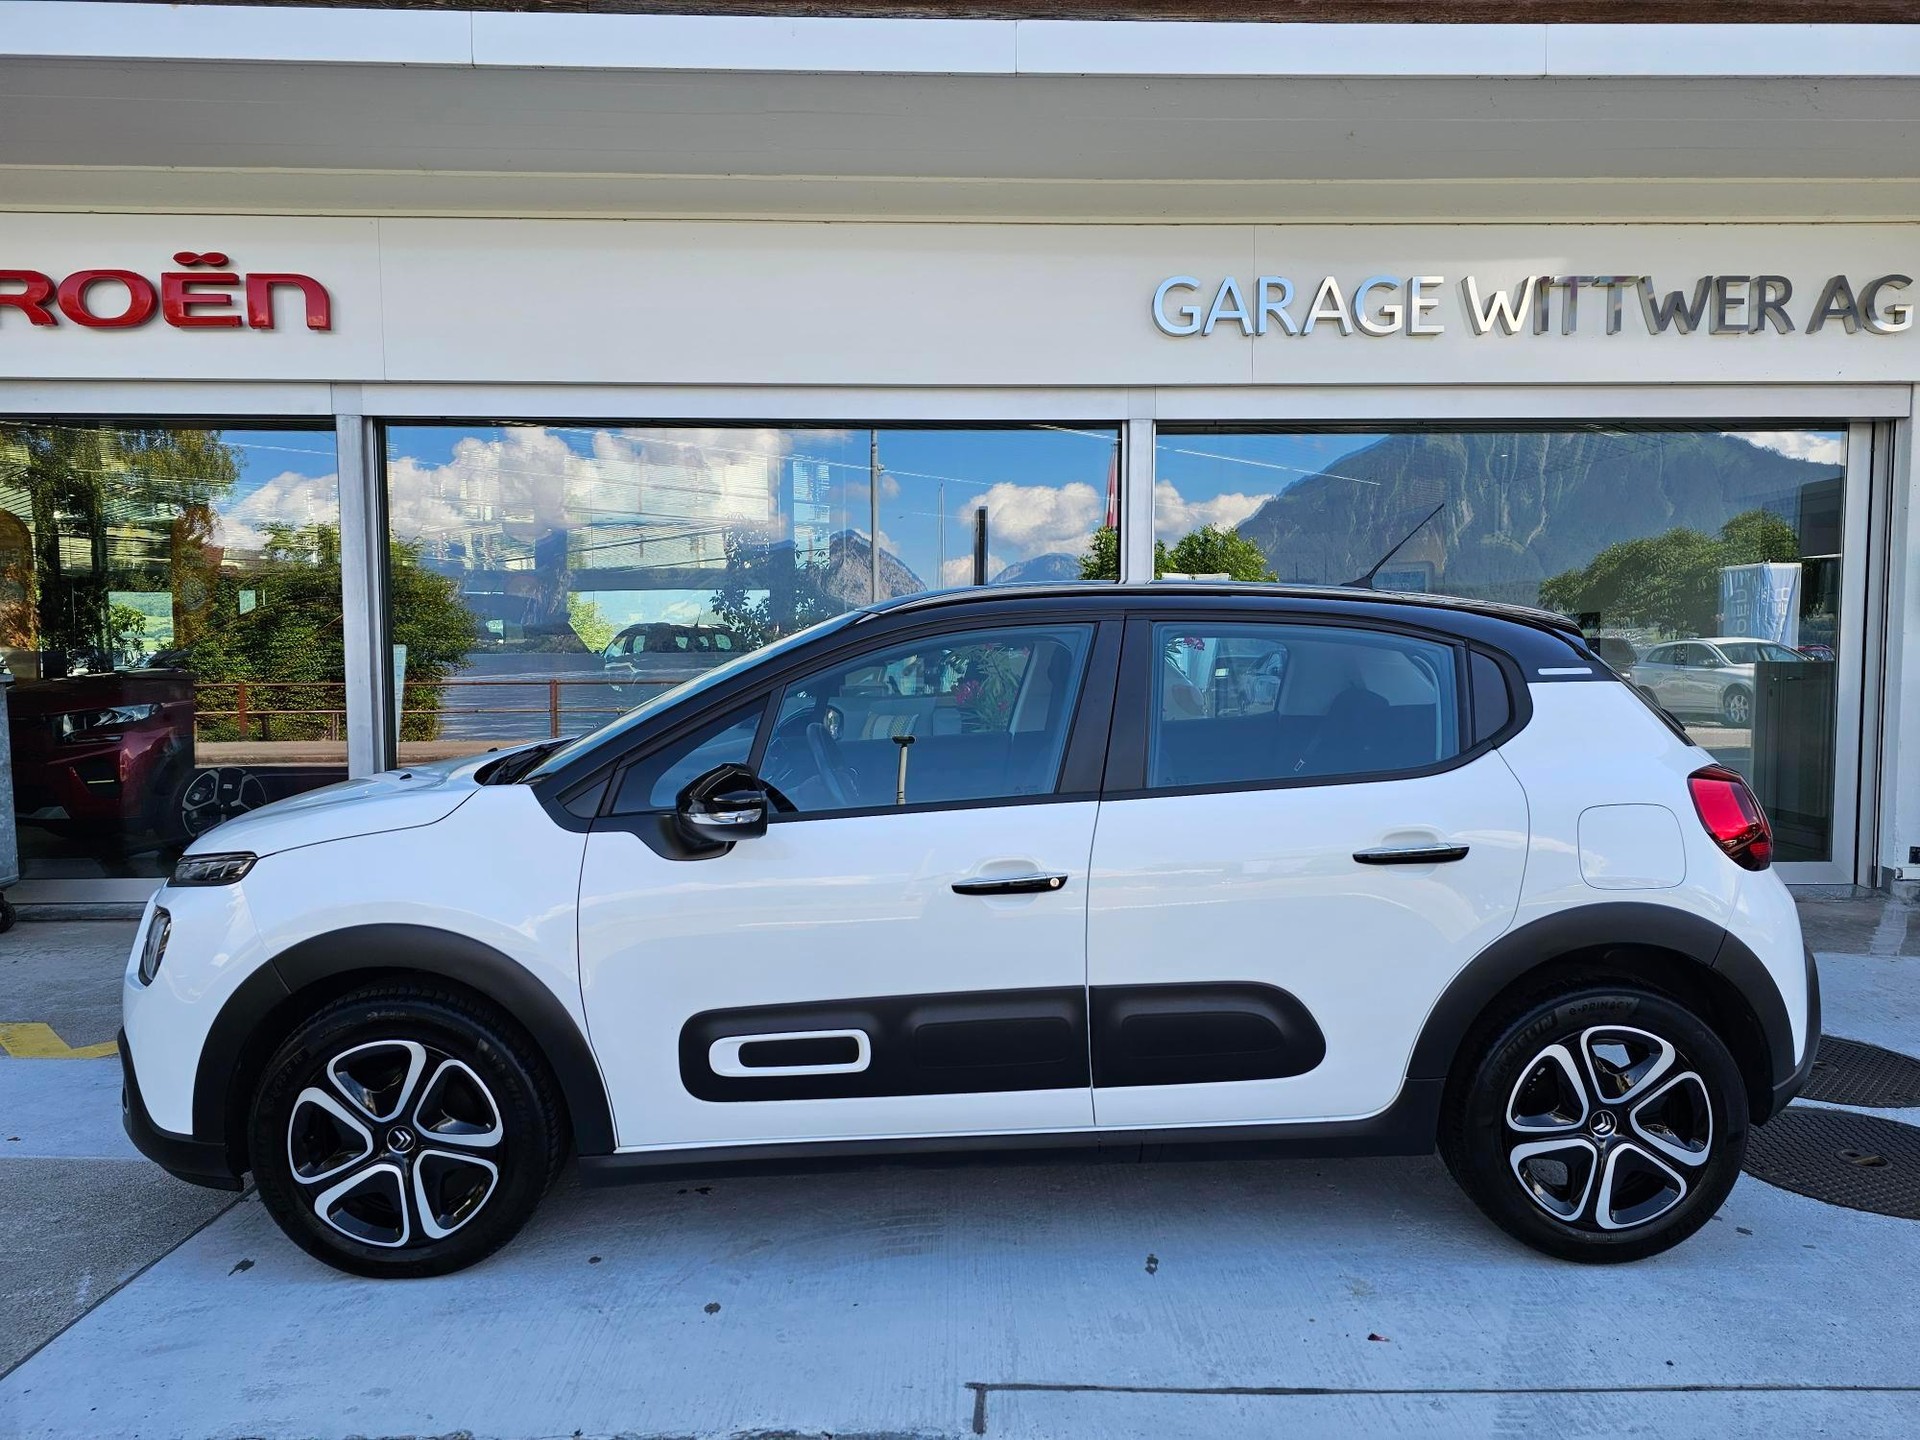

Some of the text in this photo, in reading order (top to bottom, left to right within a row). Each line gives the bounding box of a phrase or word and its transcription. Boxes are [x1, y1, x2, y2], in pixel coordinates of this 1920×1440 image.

[1152, 274, 1914, 337] GARAGE WITTWER AG
